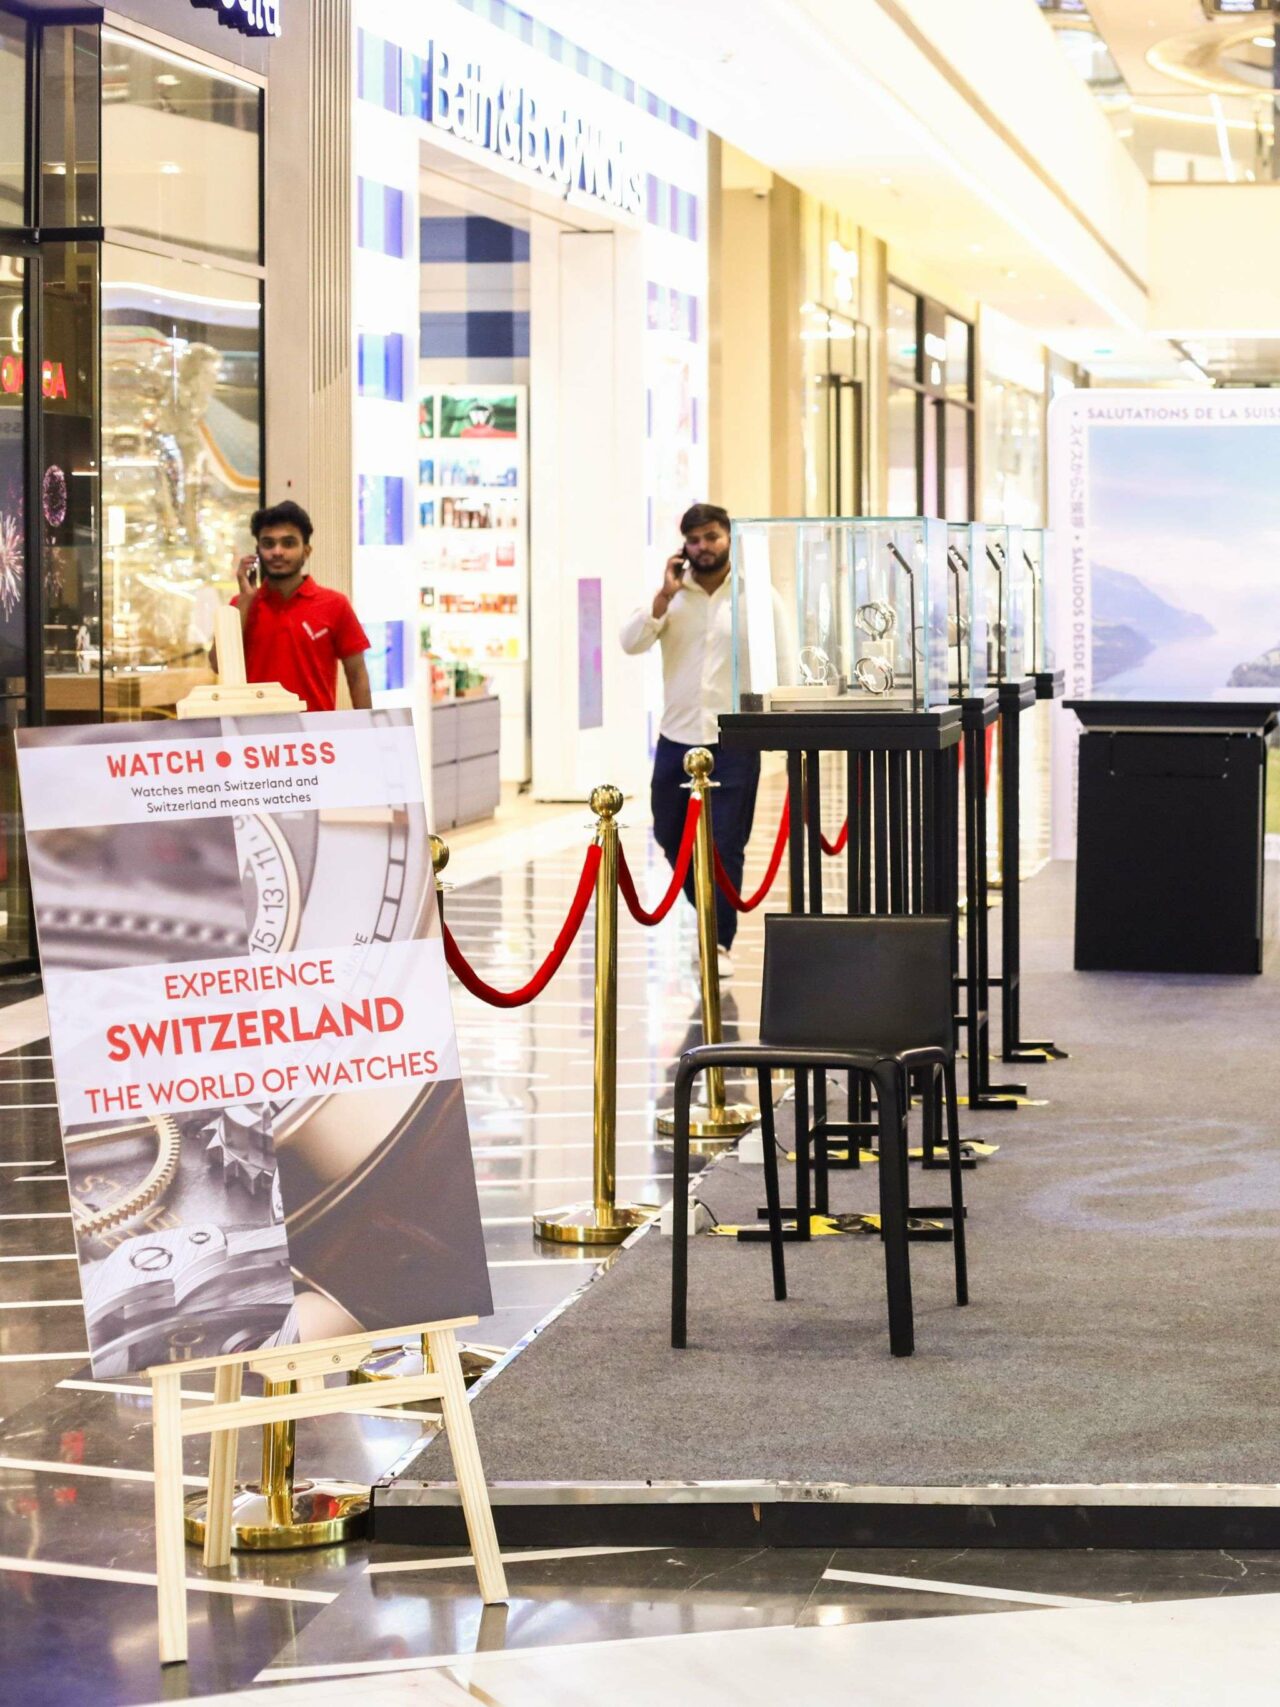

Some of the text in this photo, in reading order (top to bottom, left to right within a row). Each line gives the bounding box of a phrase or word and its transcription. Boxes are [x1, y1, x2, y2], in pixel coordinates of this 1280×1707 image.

[1087, 407, 1189, 420] SALUTATIONS
[1194, 407, 1214, 420] DE
[1219, 407, 1238, 419] LA
[1072, 547, 1085, 618] SALUDOS
[1073, 623, 1085, 671] DESDE
[106, 741, 337, 778] WATCH SWISS
[131, 775, 319, 798] Watches mean Switzerland and
[146, 791, 312, 814] Switzerland means watches
[262, 888, 285, 914] 13
[164, 960, 336, 1000] EXPERIENCE
[106, 997, 405, 1063] SWITZERLAND
[85, 1049, 440, 1113] THE WORLD OF WATCHES
